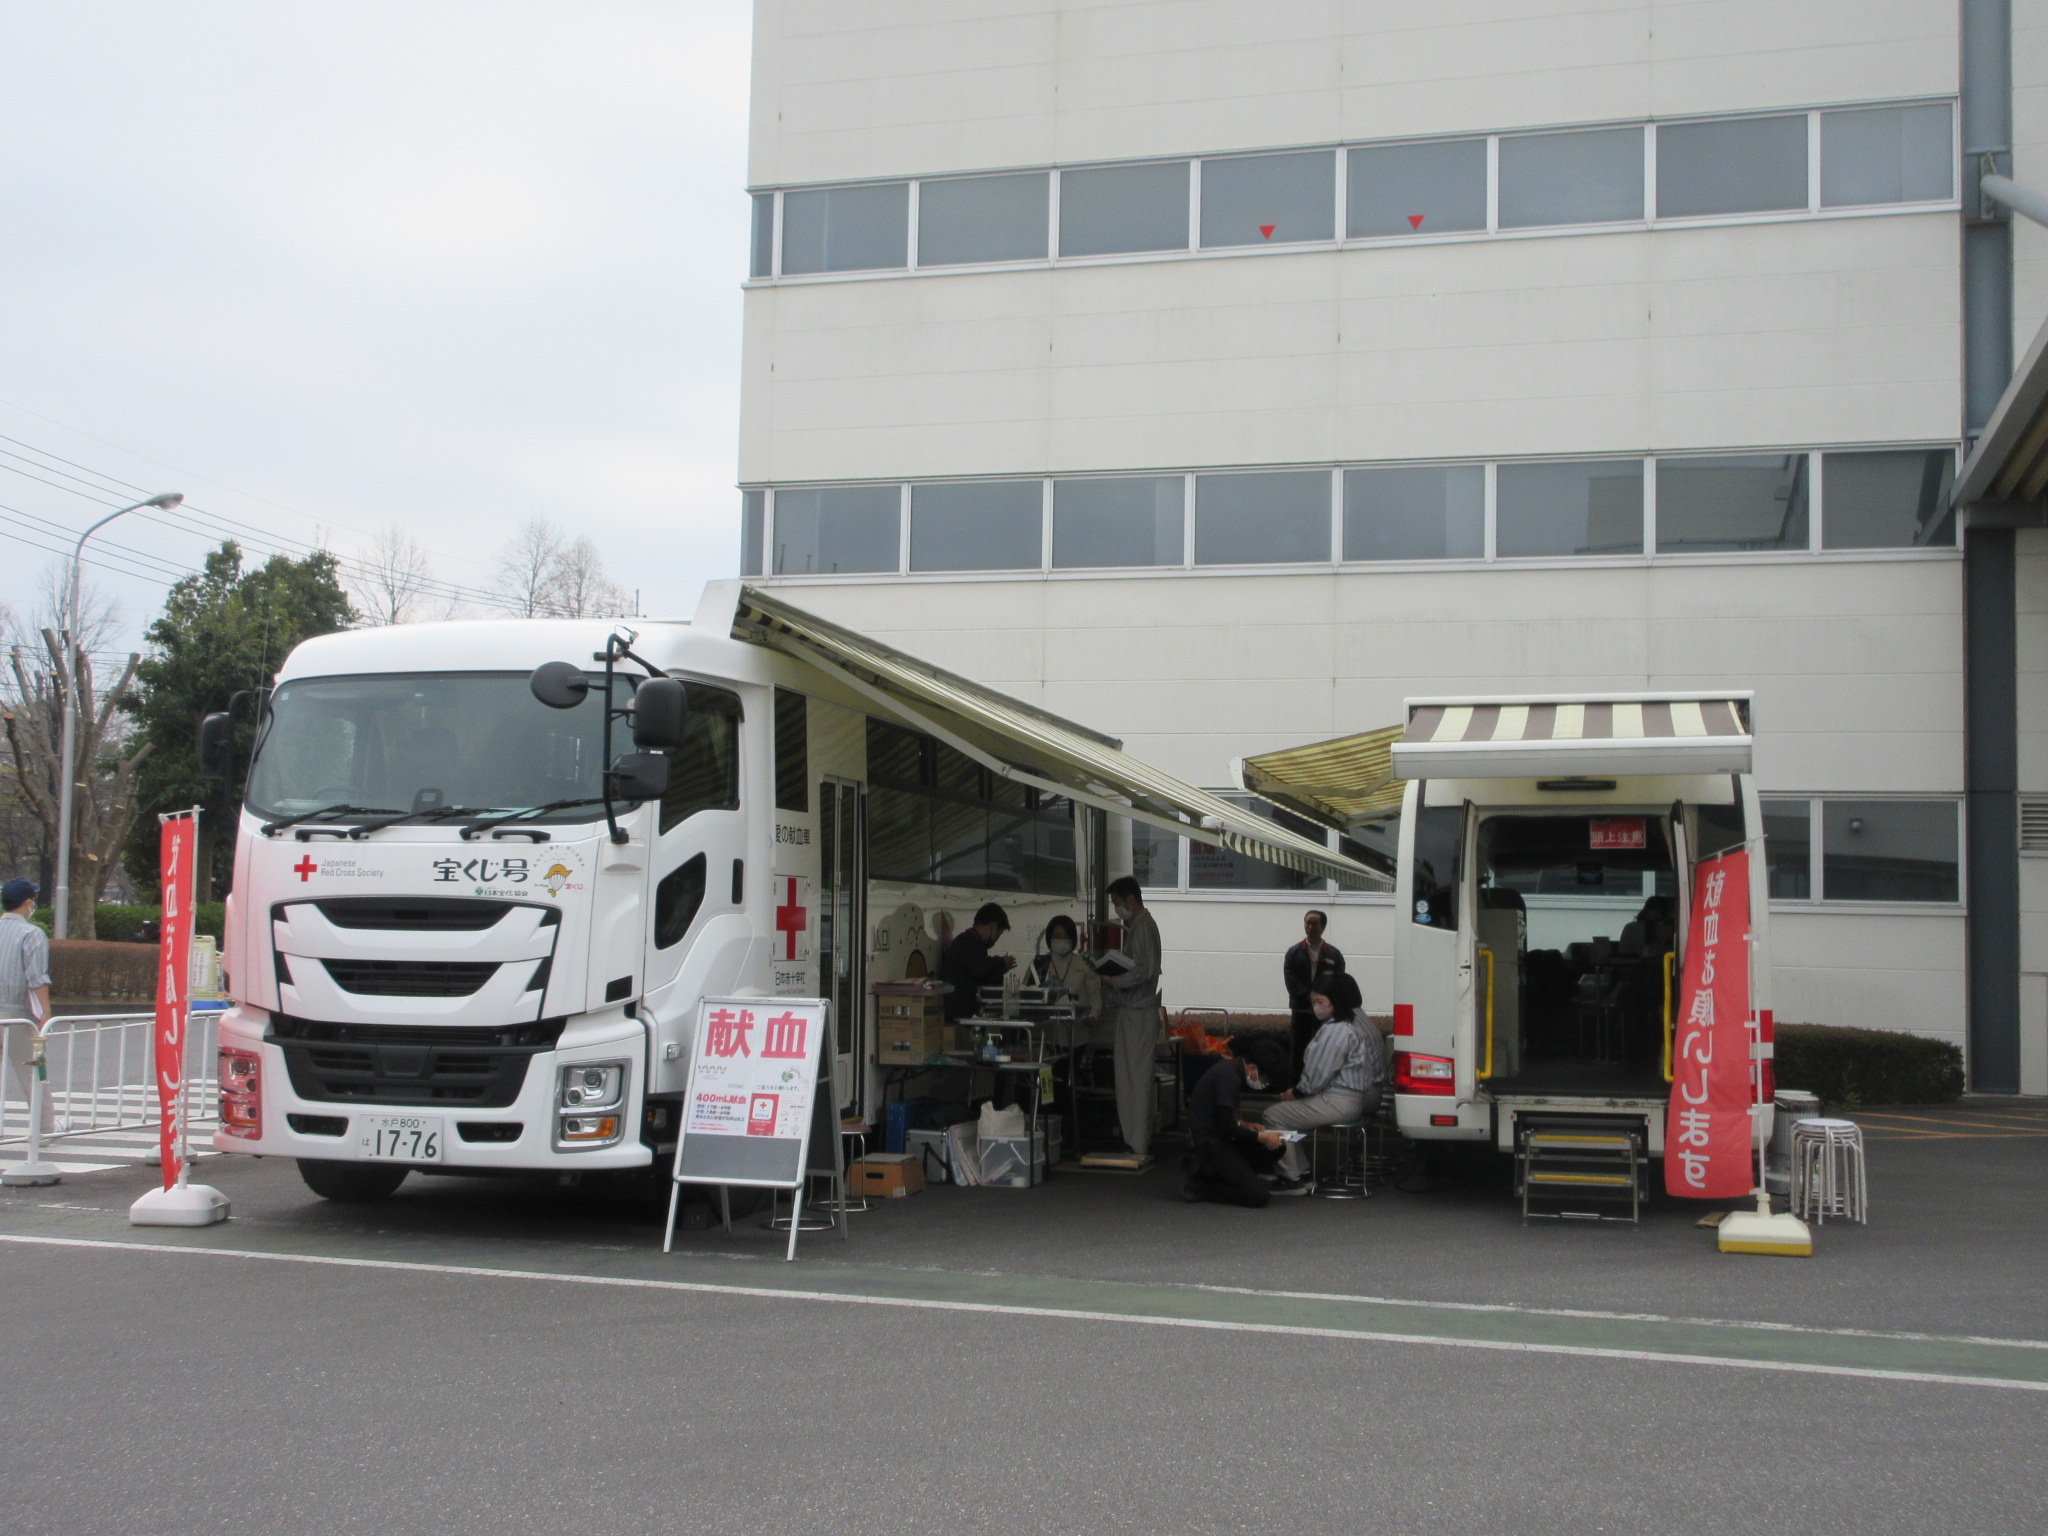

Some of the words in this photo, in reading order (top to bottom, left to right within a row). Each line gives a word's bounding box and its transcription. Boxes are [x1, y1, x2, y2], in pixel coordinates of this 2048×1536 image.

[775, 824, 810, 845] 愛の献血車
[1591, 830, 1644, 844] 頭上注意
[322, 859, 356, 868] Japanese
[433, 857, 530, 883] 宝くじ号
[321, 868, 334, 877] Red
[335, 868, 355, 877] Cross
[357, 868, 384, 878] Society
[484, 889, 528, 897] 日本宝くじ協会
[775, 971, 806, 986] 日本赤十字社
[704, 1008, 808, 1059] 献血
[696, 1093, 747, 1104] 400mL献血
[362, 1138, 370, 1146] は
[376, 1129, 437, 1158] 17-76
